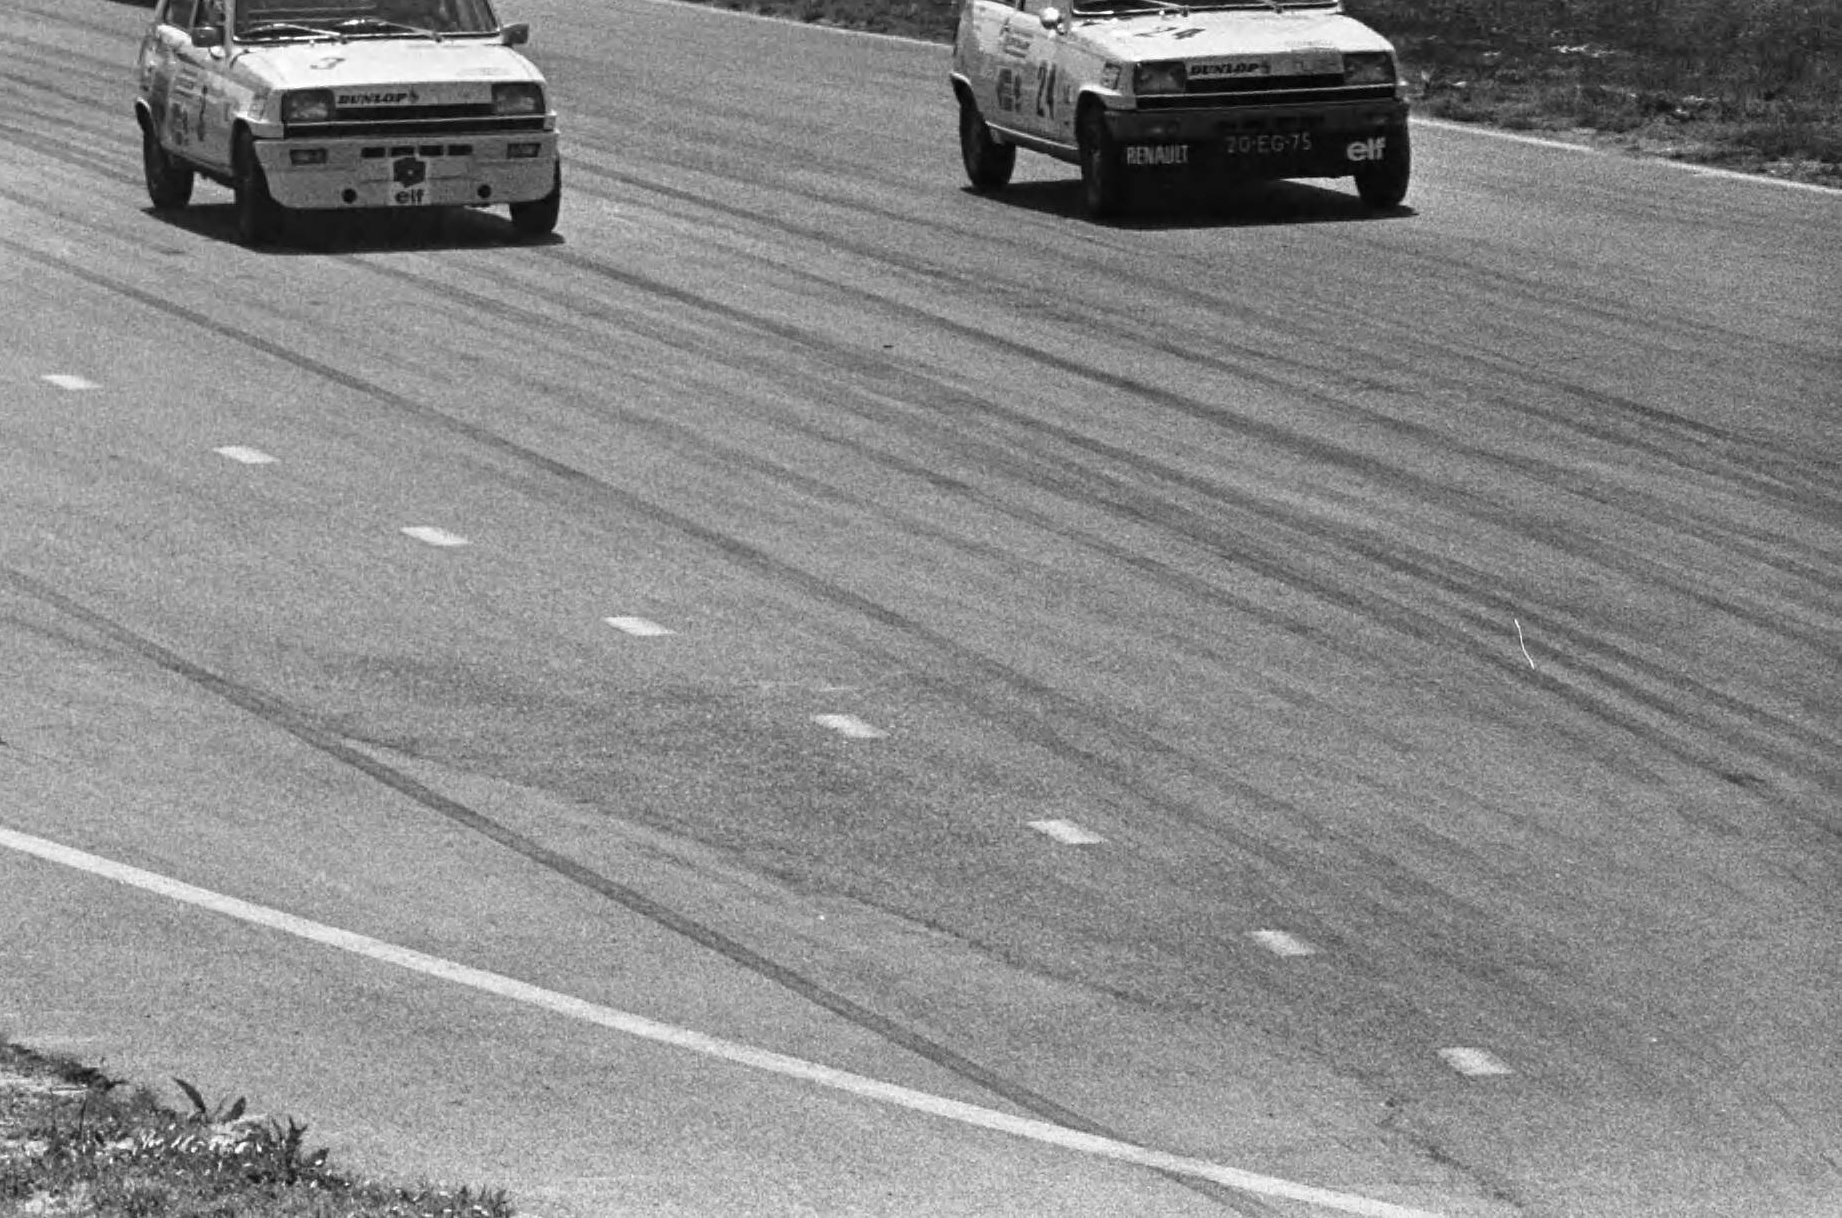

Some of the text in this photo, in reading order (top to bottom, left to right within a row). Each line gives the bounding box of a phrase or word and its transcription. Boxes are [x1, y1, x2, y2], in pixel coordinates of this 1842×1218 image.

[1189, 63, 1258, 76] DUNLOP
[337, 92, 408, 105] DUNLOP
[1126, 144, 1189, 166] RENAULT
[1346, 136, 1387, 162] elf
[394, 188, 425, 204] elf
